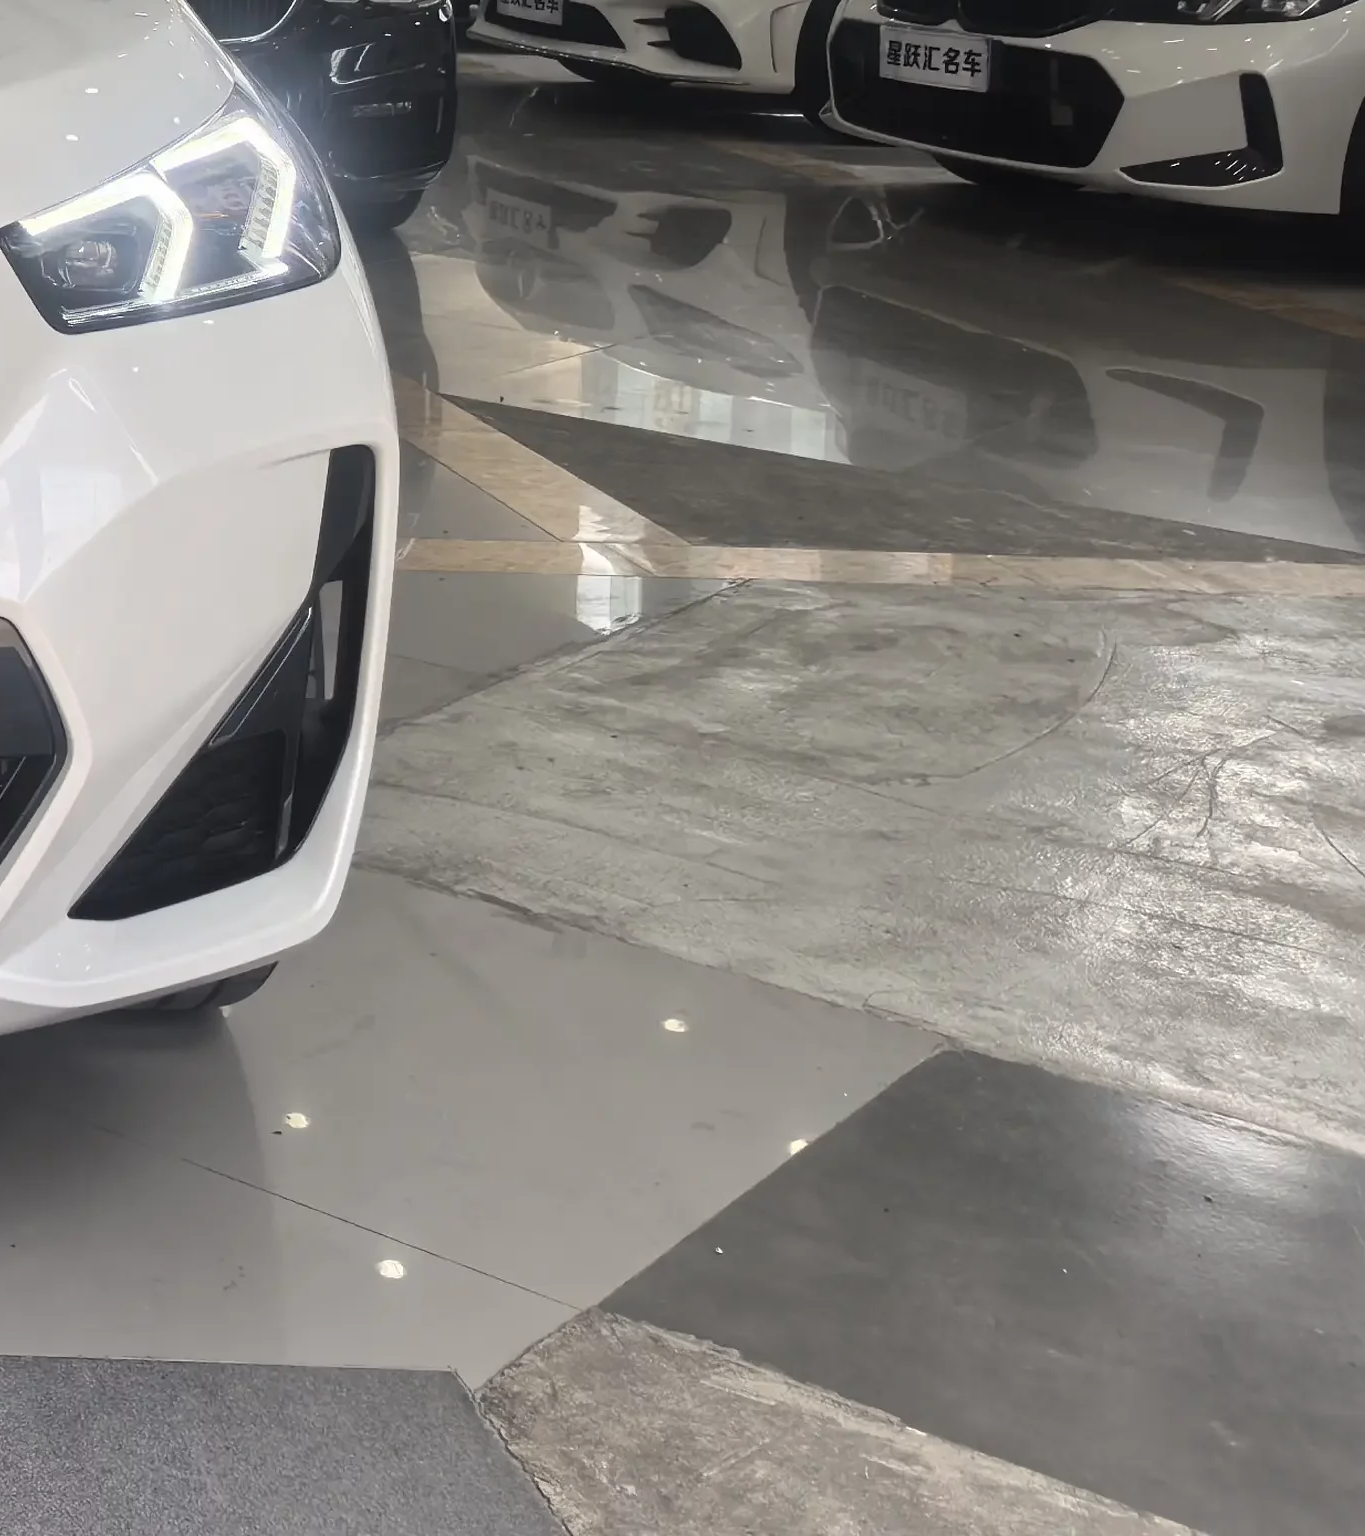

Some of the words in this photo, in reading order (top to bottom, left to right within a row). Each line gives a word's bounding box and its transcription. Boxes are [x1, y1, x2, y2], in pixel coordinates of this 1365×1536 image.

[886, 40, 982, 77] 星跃汇名车
